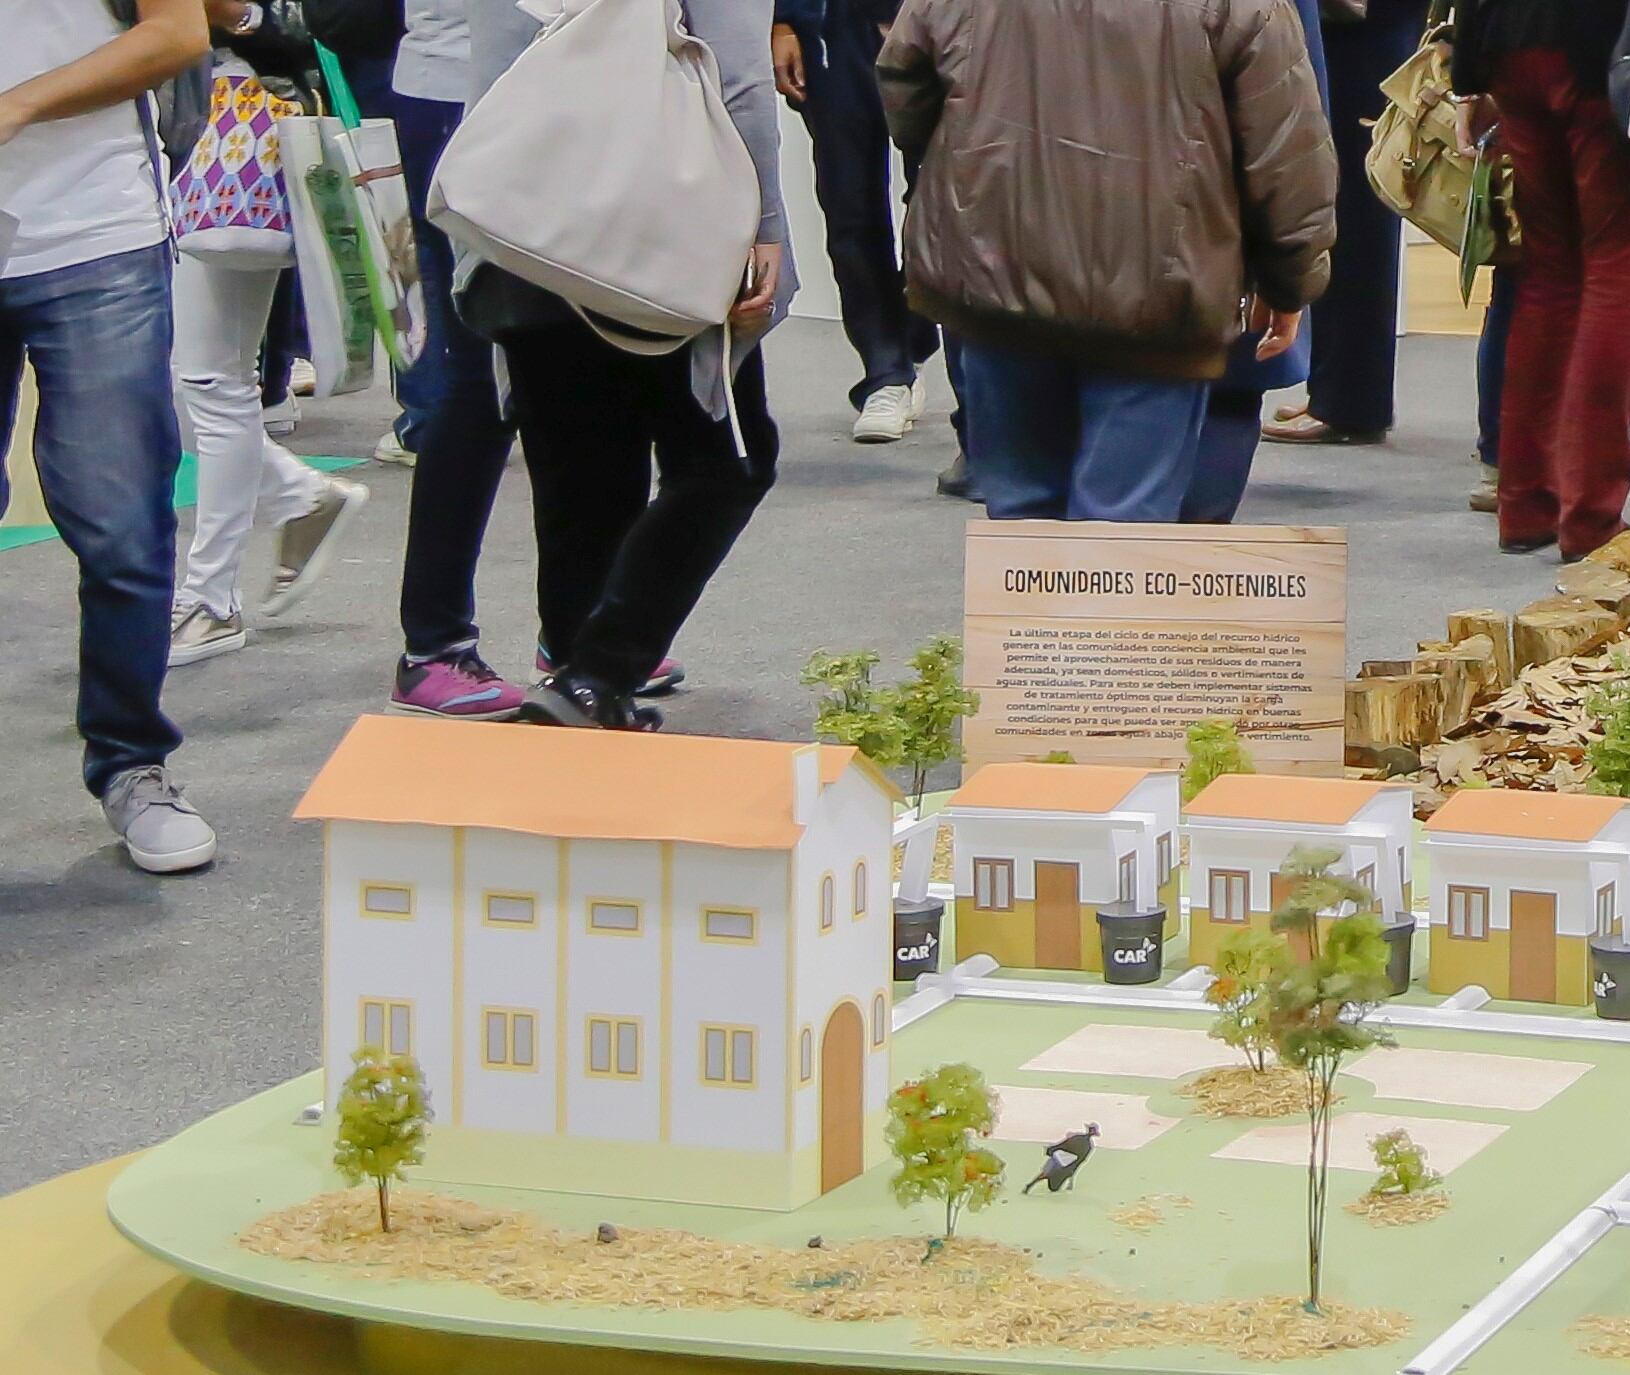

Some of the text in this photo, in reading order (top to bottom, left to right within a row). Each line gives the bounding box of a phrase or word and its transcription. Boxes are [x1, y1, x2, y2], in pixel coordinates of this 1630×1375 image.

[1004, 569, 1306, 598] COMUNIDADES ECO-SOSTENIBLES
[1009, 628, 1300, 643] La última etapa del ciclo de manejo del recurso hídrico
[1003, 642, 1306, 656] genera en las comunidades conciencia ambiental que les
[1007, 654, 1301, 667] permite el aprovechamiento de sus residuos de manera
[1004, 666, 1058, 676] adecuada,
[1061, 668, 1074, 677] ya
[1076, 668, 1101, 676] sean
[1104, 667, 1168, 678] domésticos,
[1171, 669, 1208, 678] sólidos
[1220, 670, 1289, 679] vertimientos
[1291, 671, 1304, 680] de
[996, 679, 1027, 688] aguas
[1030, 678, 1087, 687] residuales.
[1090, 679, 1113, 688] Para
[1117, 680, 1139, 689] esto
[1156, 681, 1190, 690] deben
[1193, 682, 1262, 693] implementar
[1266, 683, 1312, 692] sistemas
[1024, 690, 1283, 706] de tratamiento óptimos que disminuyan la carga
[1006, 703, 1301, 717] contaminante y entreguen el recurso hídrico en buenas
[1008, 715, 1071, 724] condiciones
[1074, 717, 1098, 726] para
[1101, 717, 1122, 726] que
[1124, 717, 1157, 726] pueda
[1160, 718, 1176, 726] ser
[995, 727, 1067, 737] comunidades
[1070, 729, 1083, 737] en
[1154, 730, 1183, 741] abajo
[1247, 732, 1312, 742] vertimiento.
[897, 944, 930, 962] CAR
[1113, 948, 1147, 964] CAR
